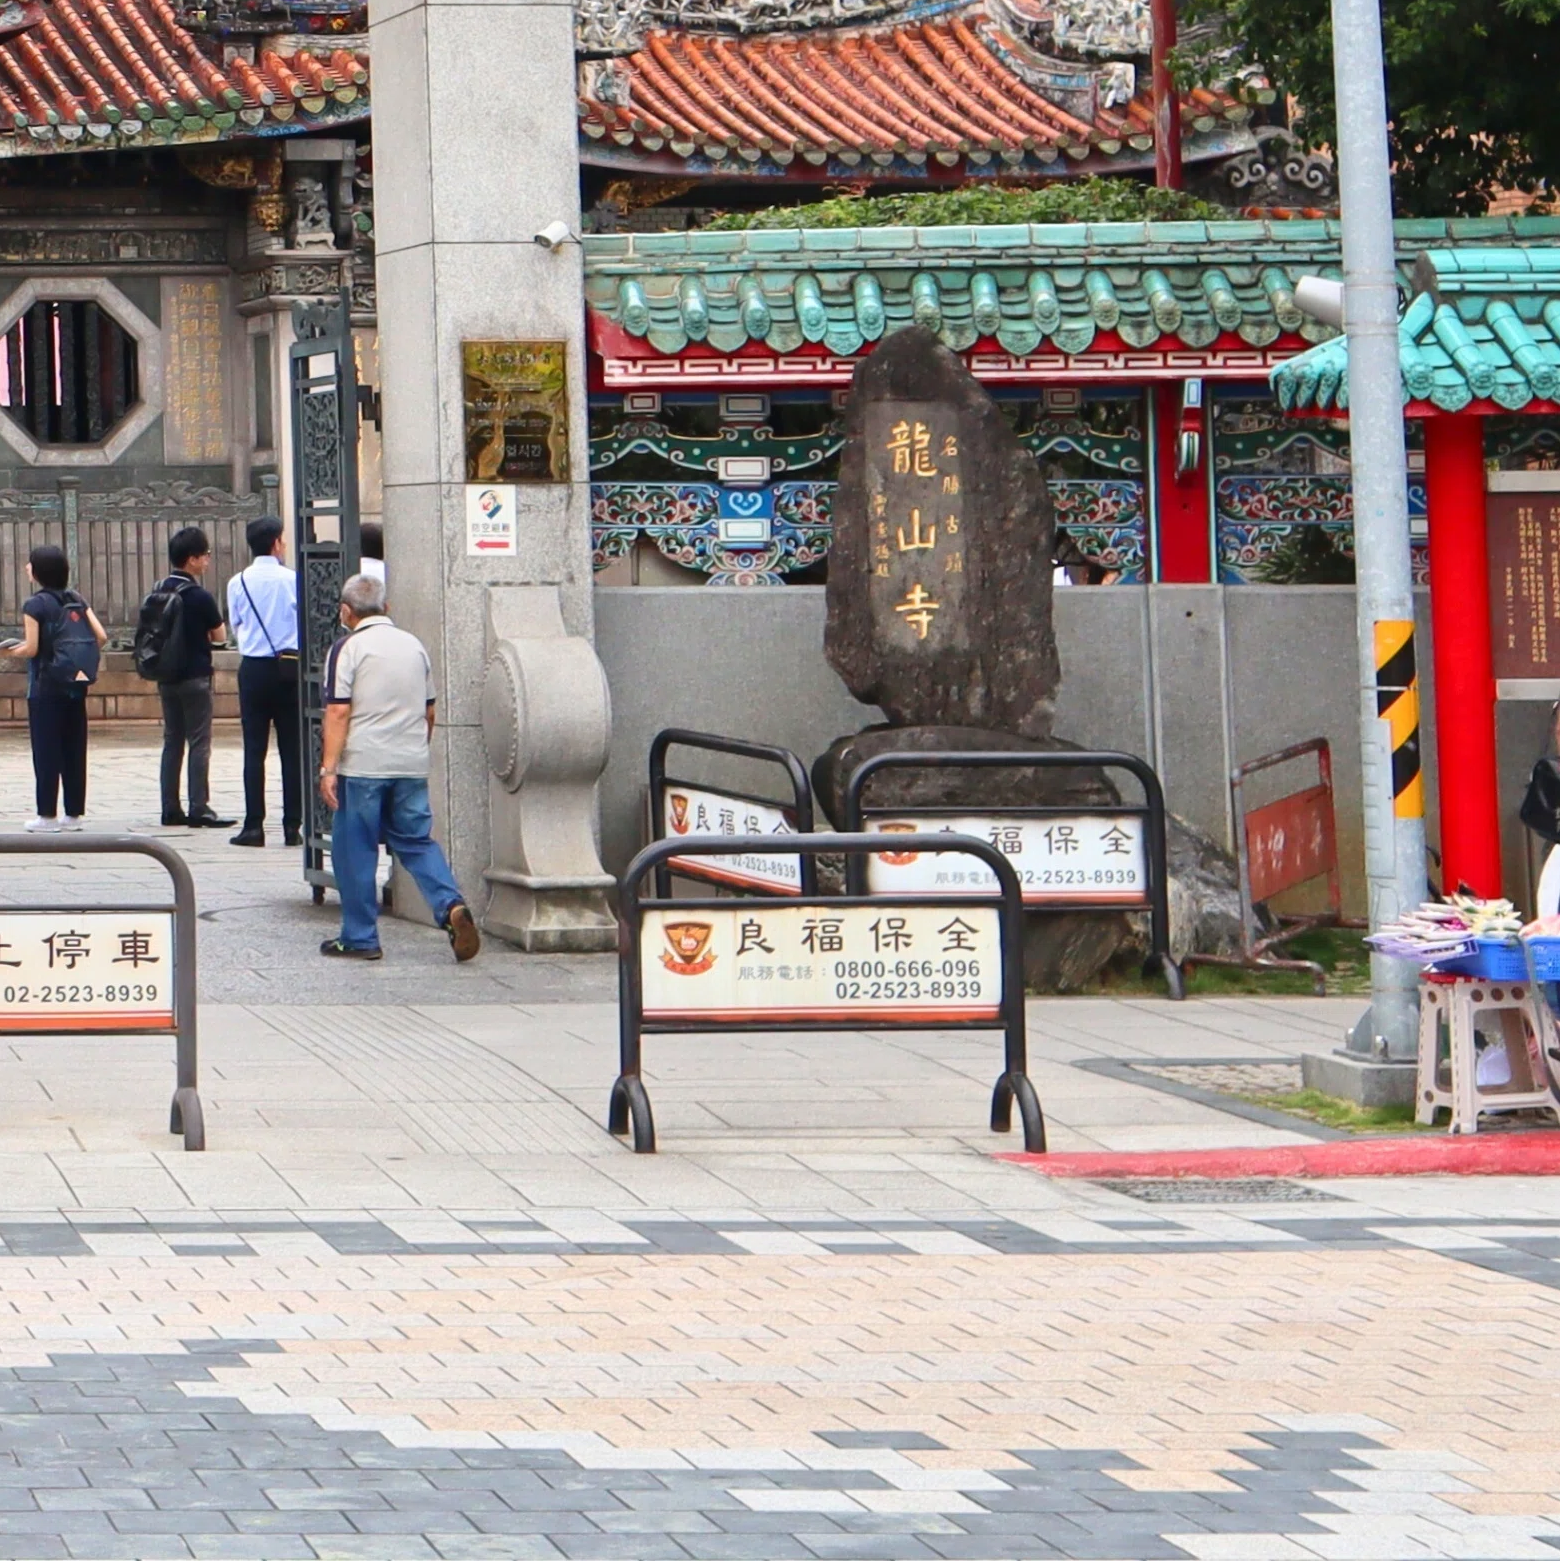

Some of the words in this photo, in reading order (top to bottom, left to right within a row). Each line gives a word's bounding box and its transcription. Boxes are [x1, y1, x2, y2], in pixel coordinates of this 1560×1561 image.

[885, 420, 940, 640] 龍山寺
[735, 916, 981, 957] 良福保全
[834, 960, 981, 979] 0800-666-096
[3, 983, 159, 1004] 02-2523-8939
[835, 981, 982, 1000] 02-2523-8939
